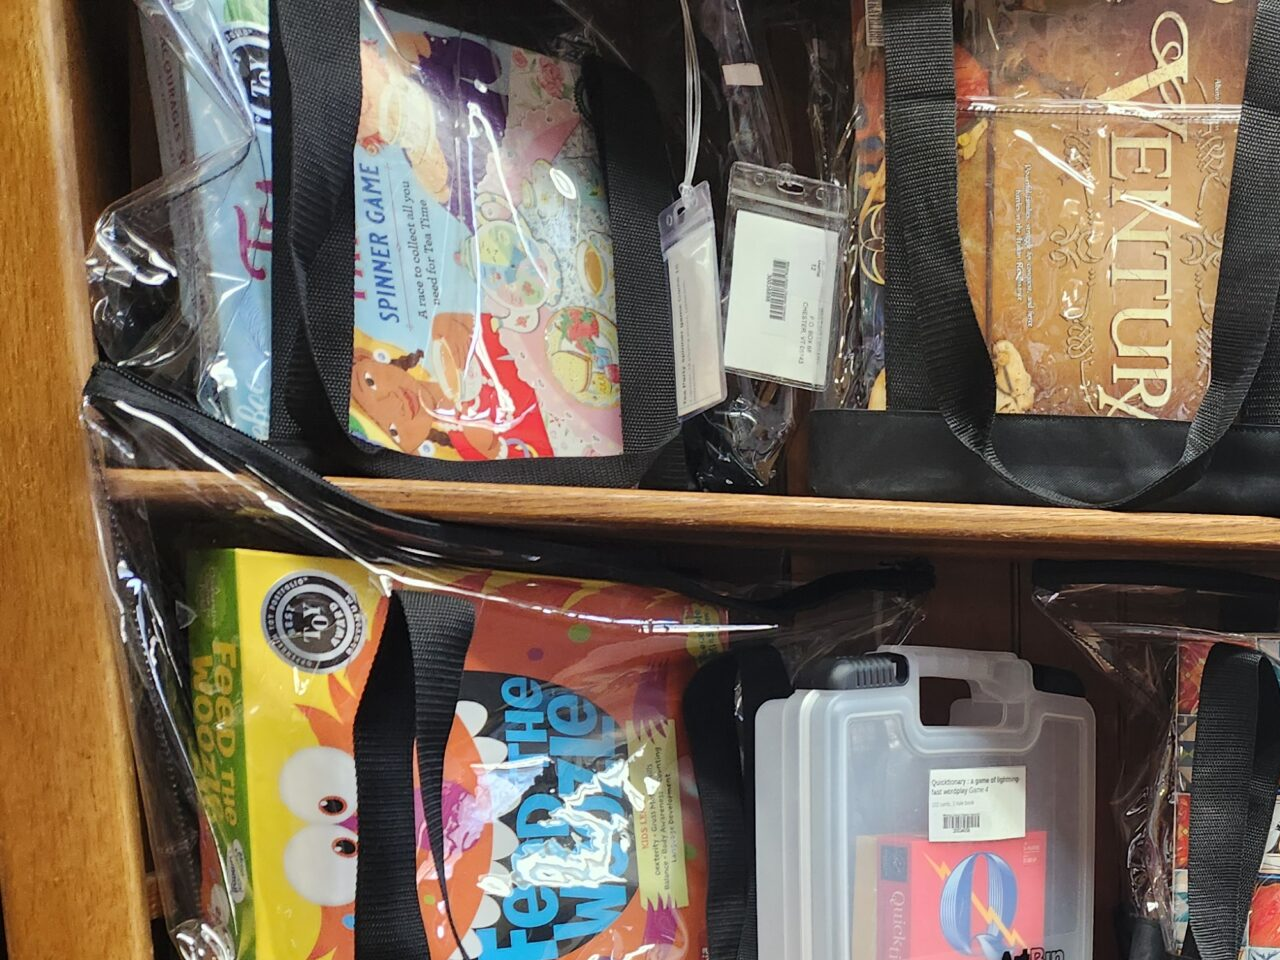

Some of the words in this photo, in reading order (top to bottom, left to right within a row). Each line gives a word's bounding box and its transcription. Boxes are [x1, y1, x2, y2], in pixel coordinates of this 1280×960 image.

[359, 163, 386, 224] GAME
[403, 181, 414, 203] you
[403, 203, 414, 220] all
[420, 199, 431, 228] Time
[1098, 12, 1190, 417] VENTUR
[408, 222, 420, 263] collect
[423, 232, 432, 254] Tea
[368, 232, 400, 323] SPINNER
[414, 265, 423, 277] to
[426, 258, 436, 277] for
[417, 281, 427, 308] race
[426, 277, 440, 305] need
[303, 602, 329, 643] TOY
[943, 787, 967, 796] wordplay
[975, 777, 989, 785] game
[665, 773, 675, 825] Development
